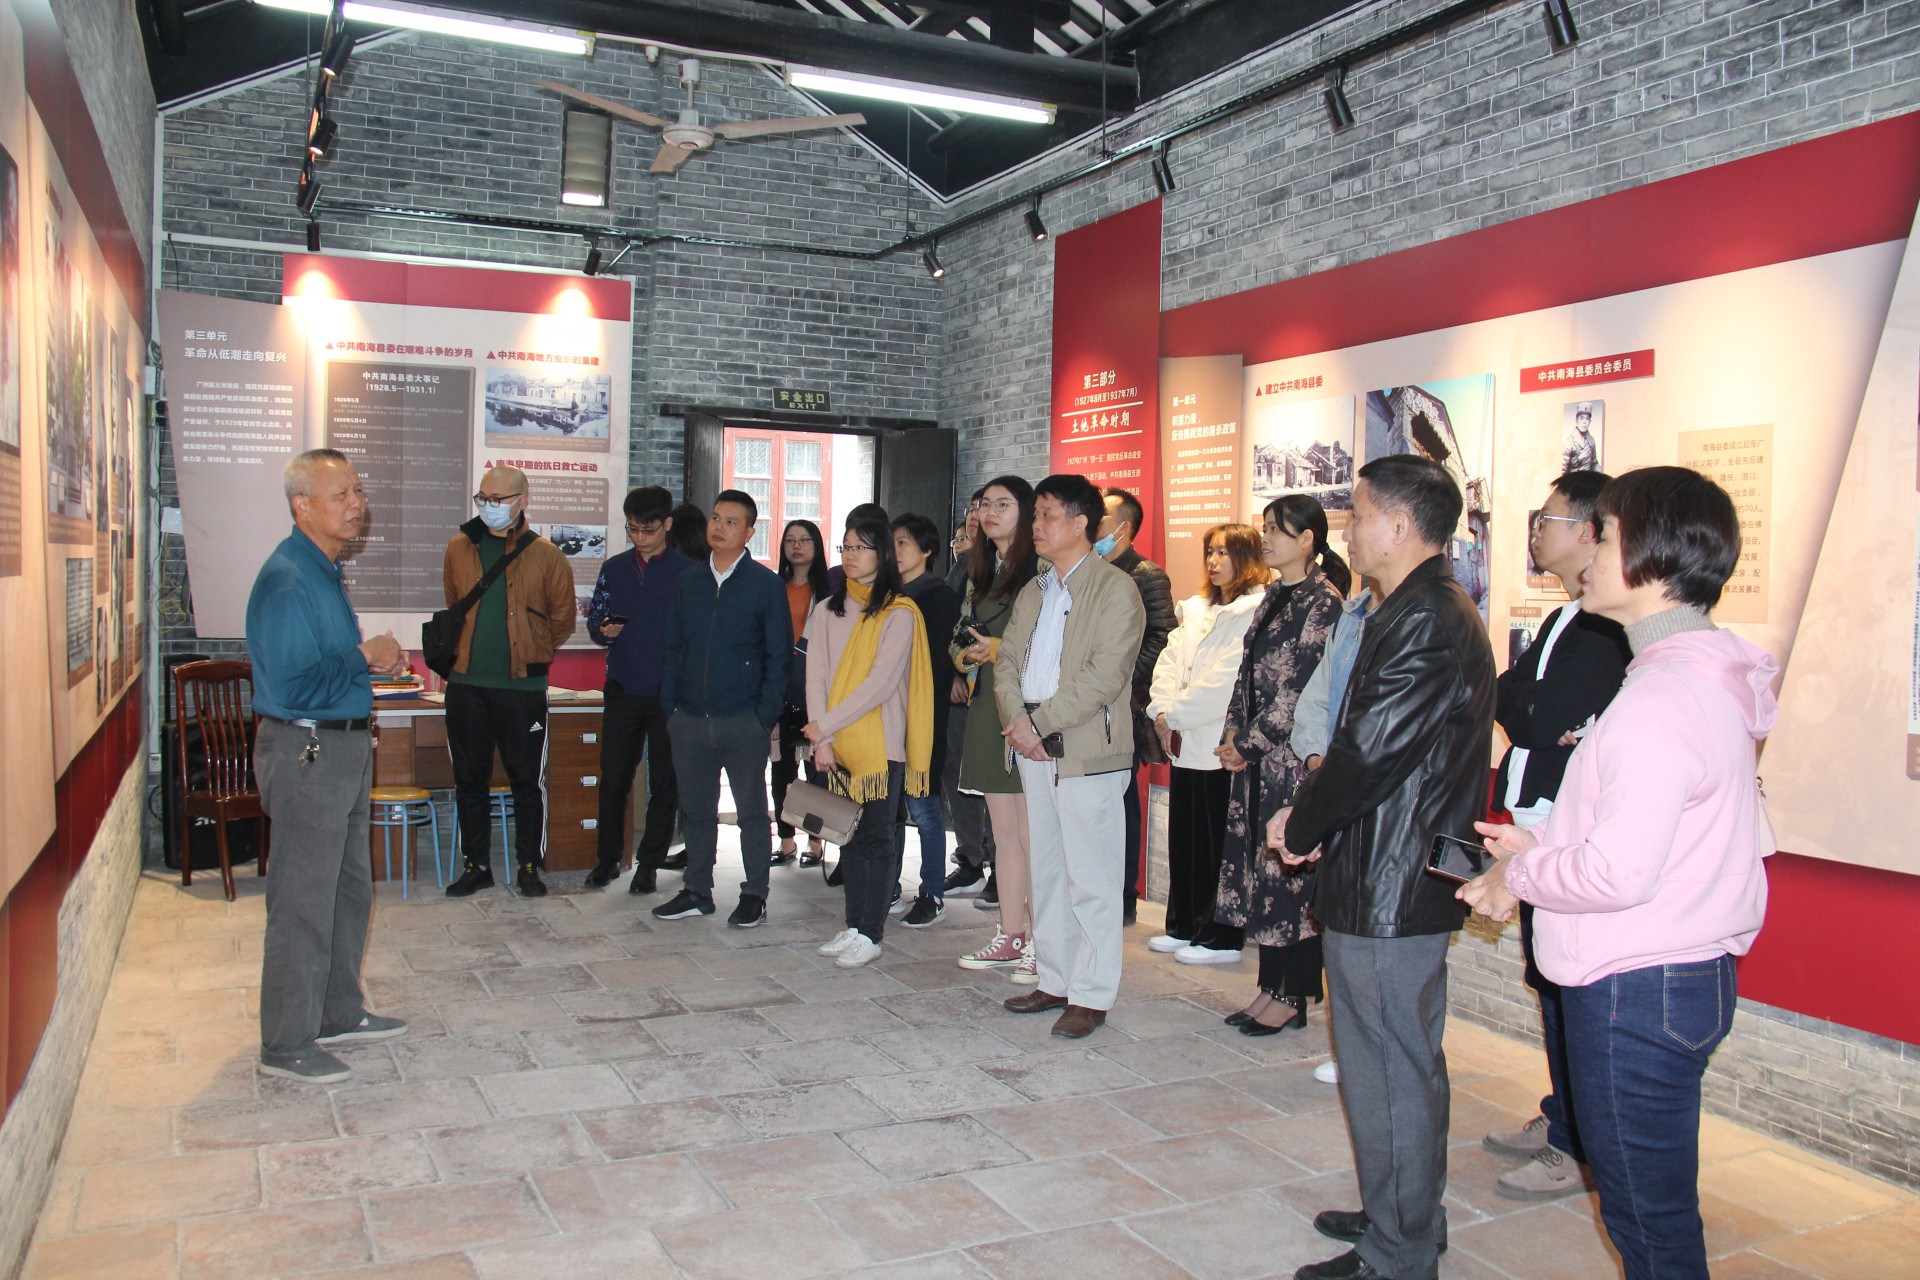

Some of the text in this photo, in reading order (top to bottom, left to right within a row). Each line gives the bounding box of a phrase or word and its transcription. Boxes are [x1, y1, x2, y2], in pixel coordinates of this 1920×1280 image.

[184, 329, 228, 341] 第三单元
[184, 347, 287, 362] 革命从低潮走向复兴
[336, 341, 473, 358] 中共南海县委在艰难斗争的岁月
[362, 371, 440, 383] 中共南海县委大事记
[1538, 358, 1632, 382] 中共南海县委员会委员
[1083, 369, 1116, 390] 第三部分
[1265, 375, 1323, 395] 建立中共南海县委
[780, 390, 825, 404] 安全出口
[1172, 393, 1197, 408] 第一单元
[789, 402, 817, 410] EXIT
[1071, 410, 1130, 434] 土地革命时期
